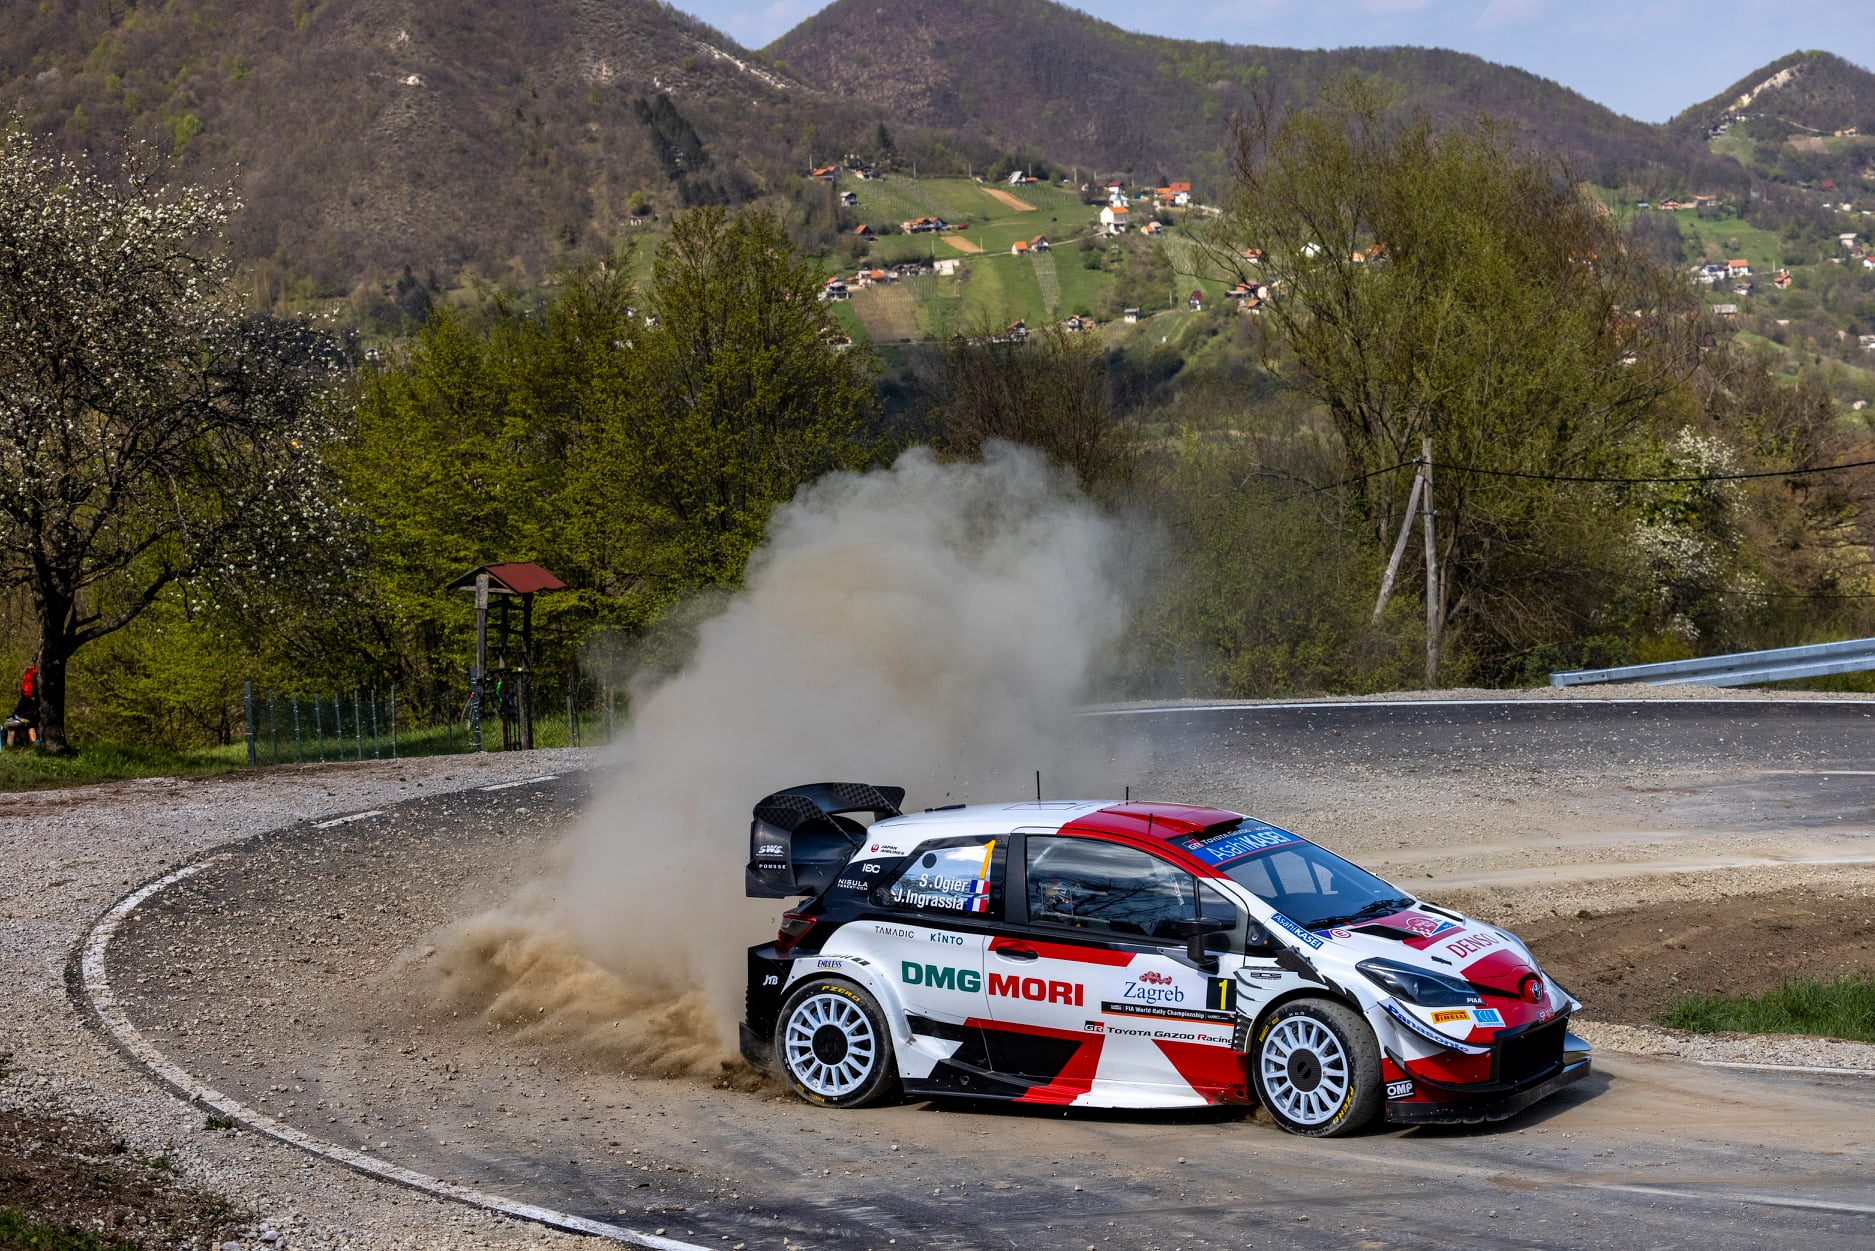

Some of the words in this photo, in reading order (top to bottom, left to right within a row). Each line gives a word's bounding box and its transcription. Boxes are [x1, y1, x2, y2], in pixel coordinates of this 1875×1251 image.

[1206, 831, 1292, 861] AsahiKASEI
[979, 839, 996, 880] 1
[838, 878, 868, 887] NISULA
[1273, 915, 1322, 949] AsahiKASEI
[1445, 932, 1500, 958] DENSO
[817, 960, 843, 969] ENDLESS
[763, 975, 779, 986] JTB
[901, 960, 981, 993] DMG
[988, 972, 1084, 1007] MORI
[1123, 981, 1185, 1004] Zagreb
[1218, 979, 1229, 1011] 1
[1136, 1006, 1151, 1014] World
[1152, 1008, 1167, 1016] Rally
[1167, 1009, 1205, 1019] Championship
[1434, 1011, 1468, 1022] PIRELLI
[1084, 1024, 1104, 1033] GR
[1107, 1026, 1151, 1037] TOYOTA
[1154, 1030, 1195, 1040] GAZOO
[1197, 1033, 1233, 1046] Racing
[1387, 1004, 1470, 1053] Panasonic
[1386, 1083, 1413, 1096] OMP
